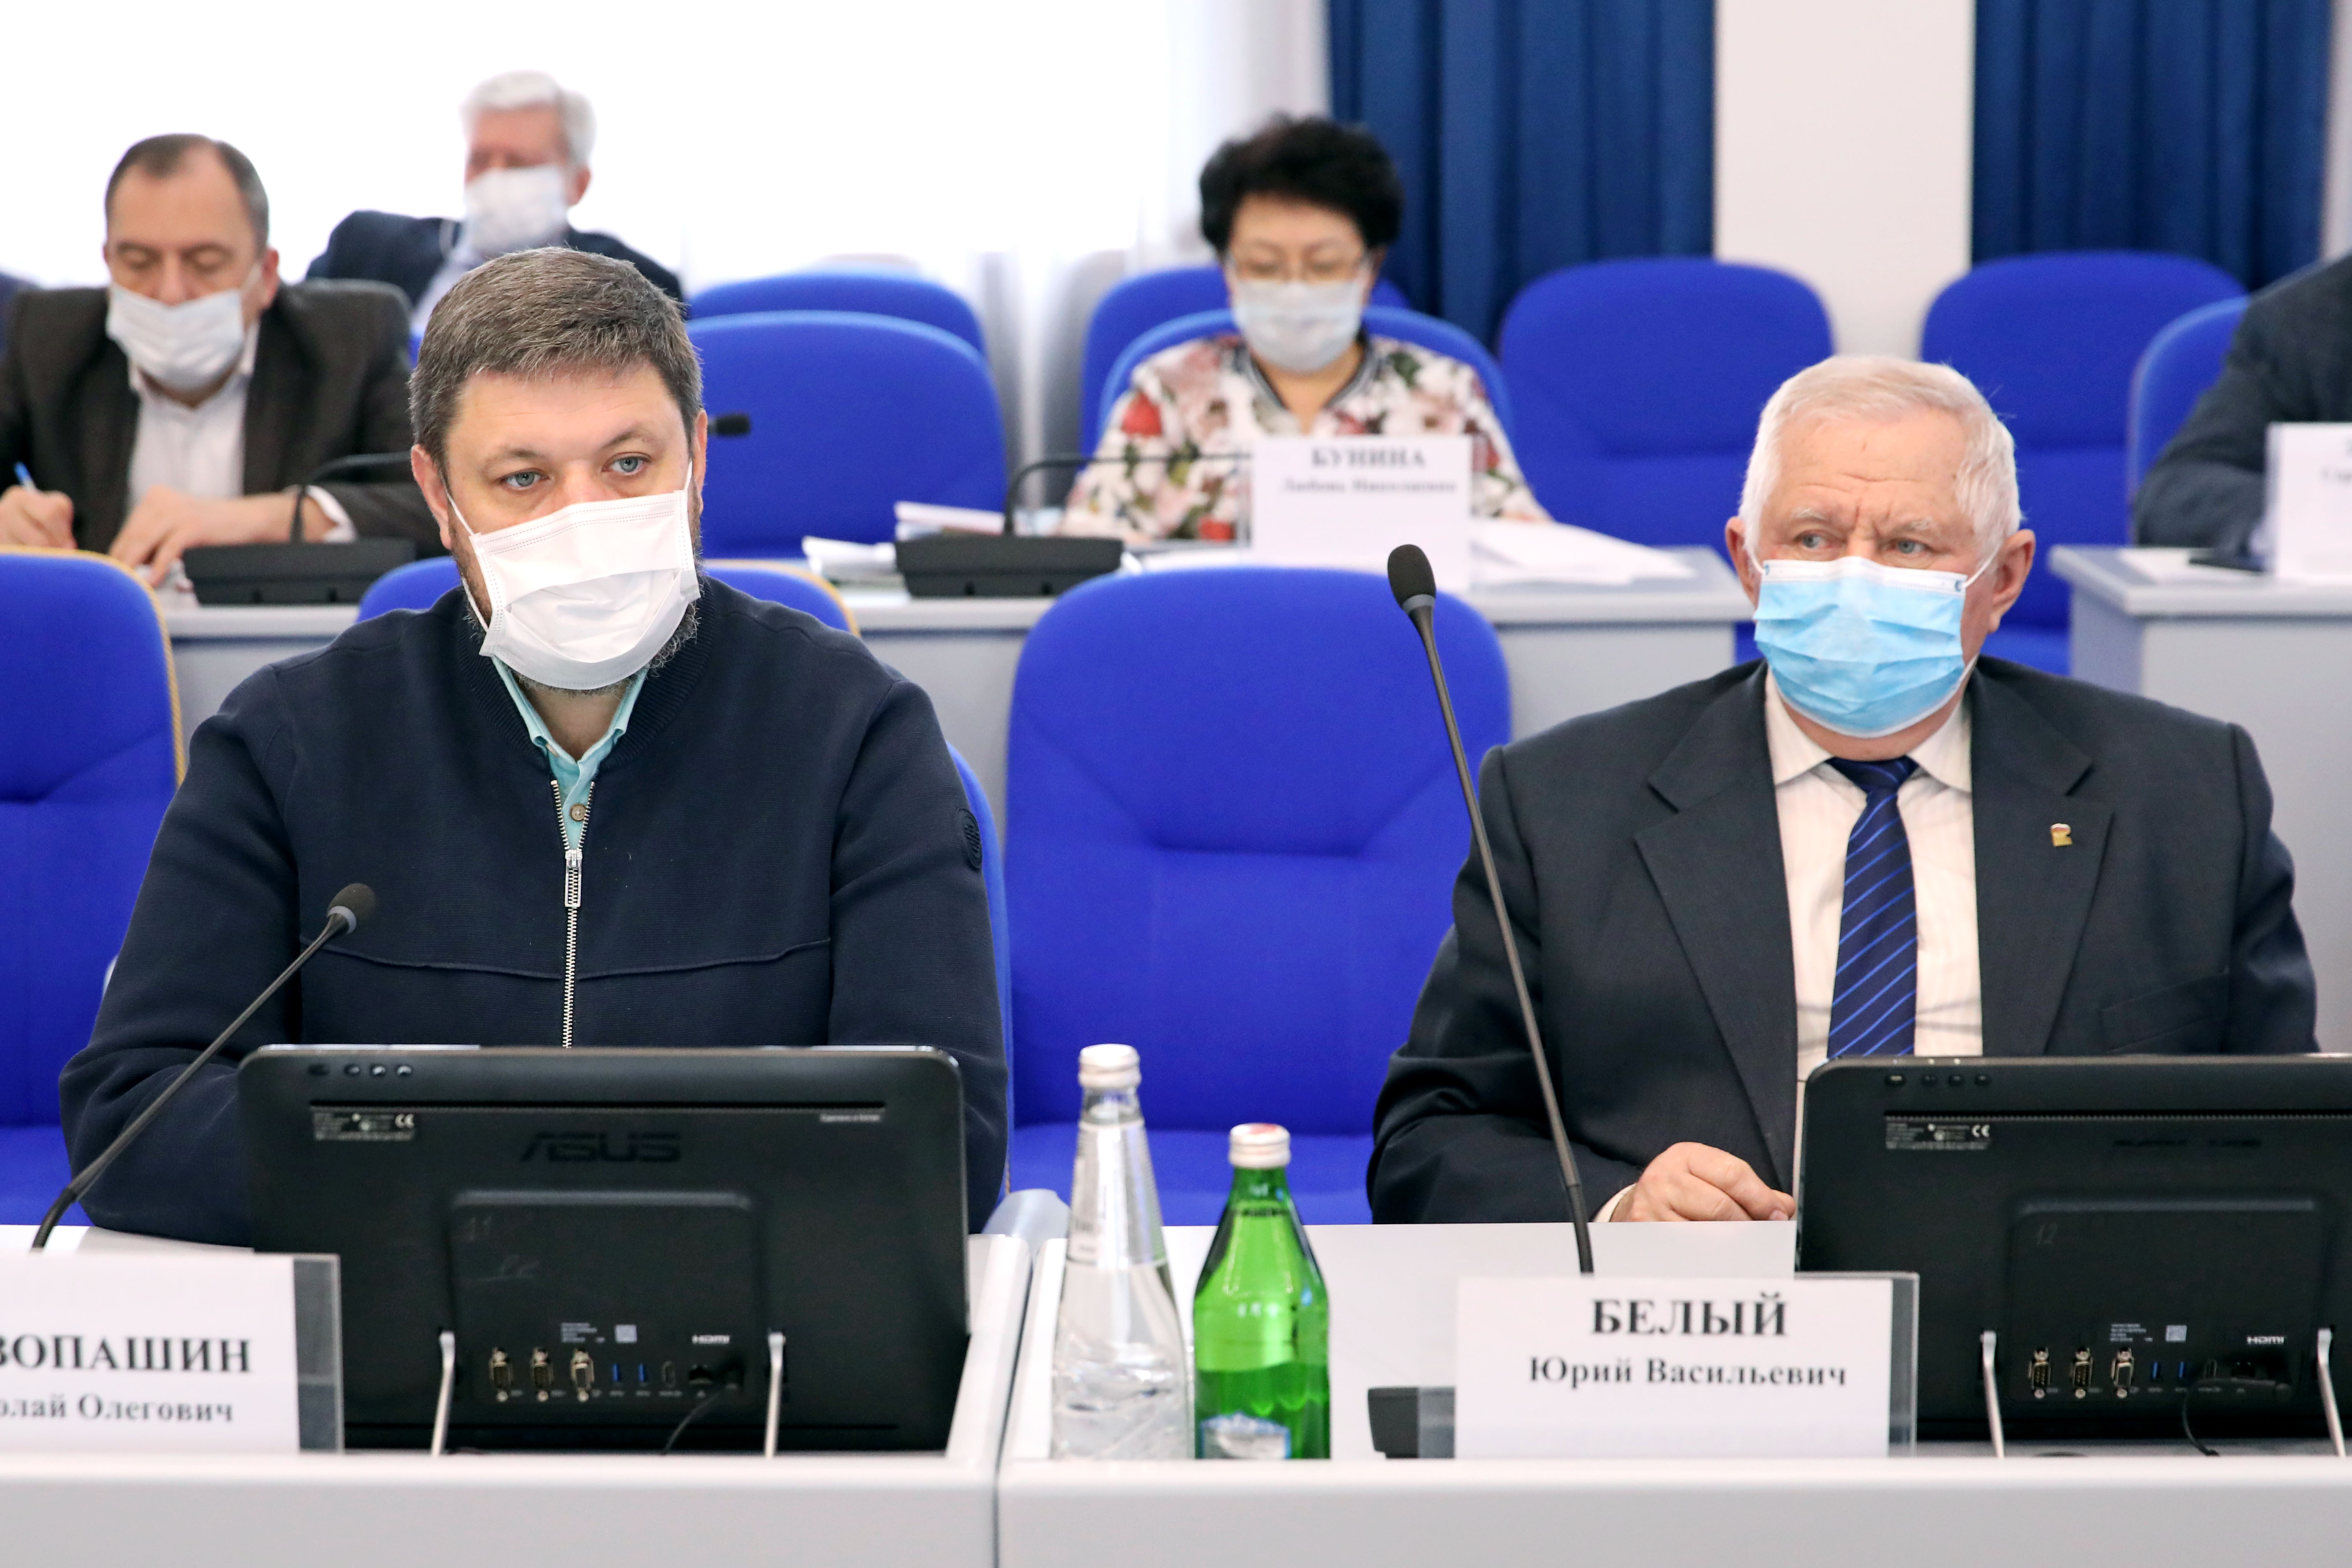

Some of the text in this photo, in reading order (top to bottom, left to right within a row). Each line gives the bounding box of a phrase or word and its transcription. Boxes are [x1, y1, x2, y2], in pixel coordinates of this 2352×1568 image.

[521, 1132, 681, 1161] ASUS
[1592, 1292, 1787, 1336] БЕЛЫЙ
[0, 1334, 251, 1373] ОПАШИН
[2246, 1336, 2285, 1344] HDMI
[1530, 1356, 1846, 1389] Юрий Васильевич
[77, 1393, 233, 1422] Олегович
